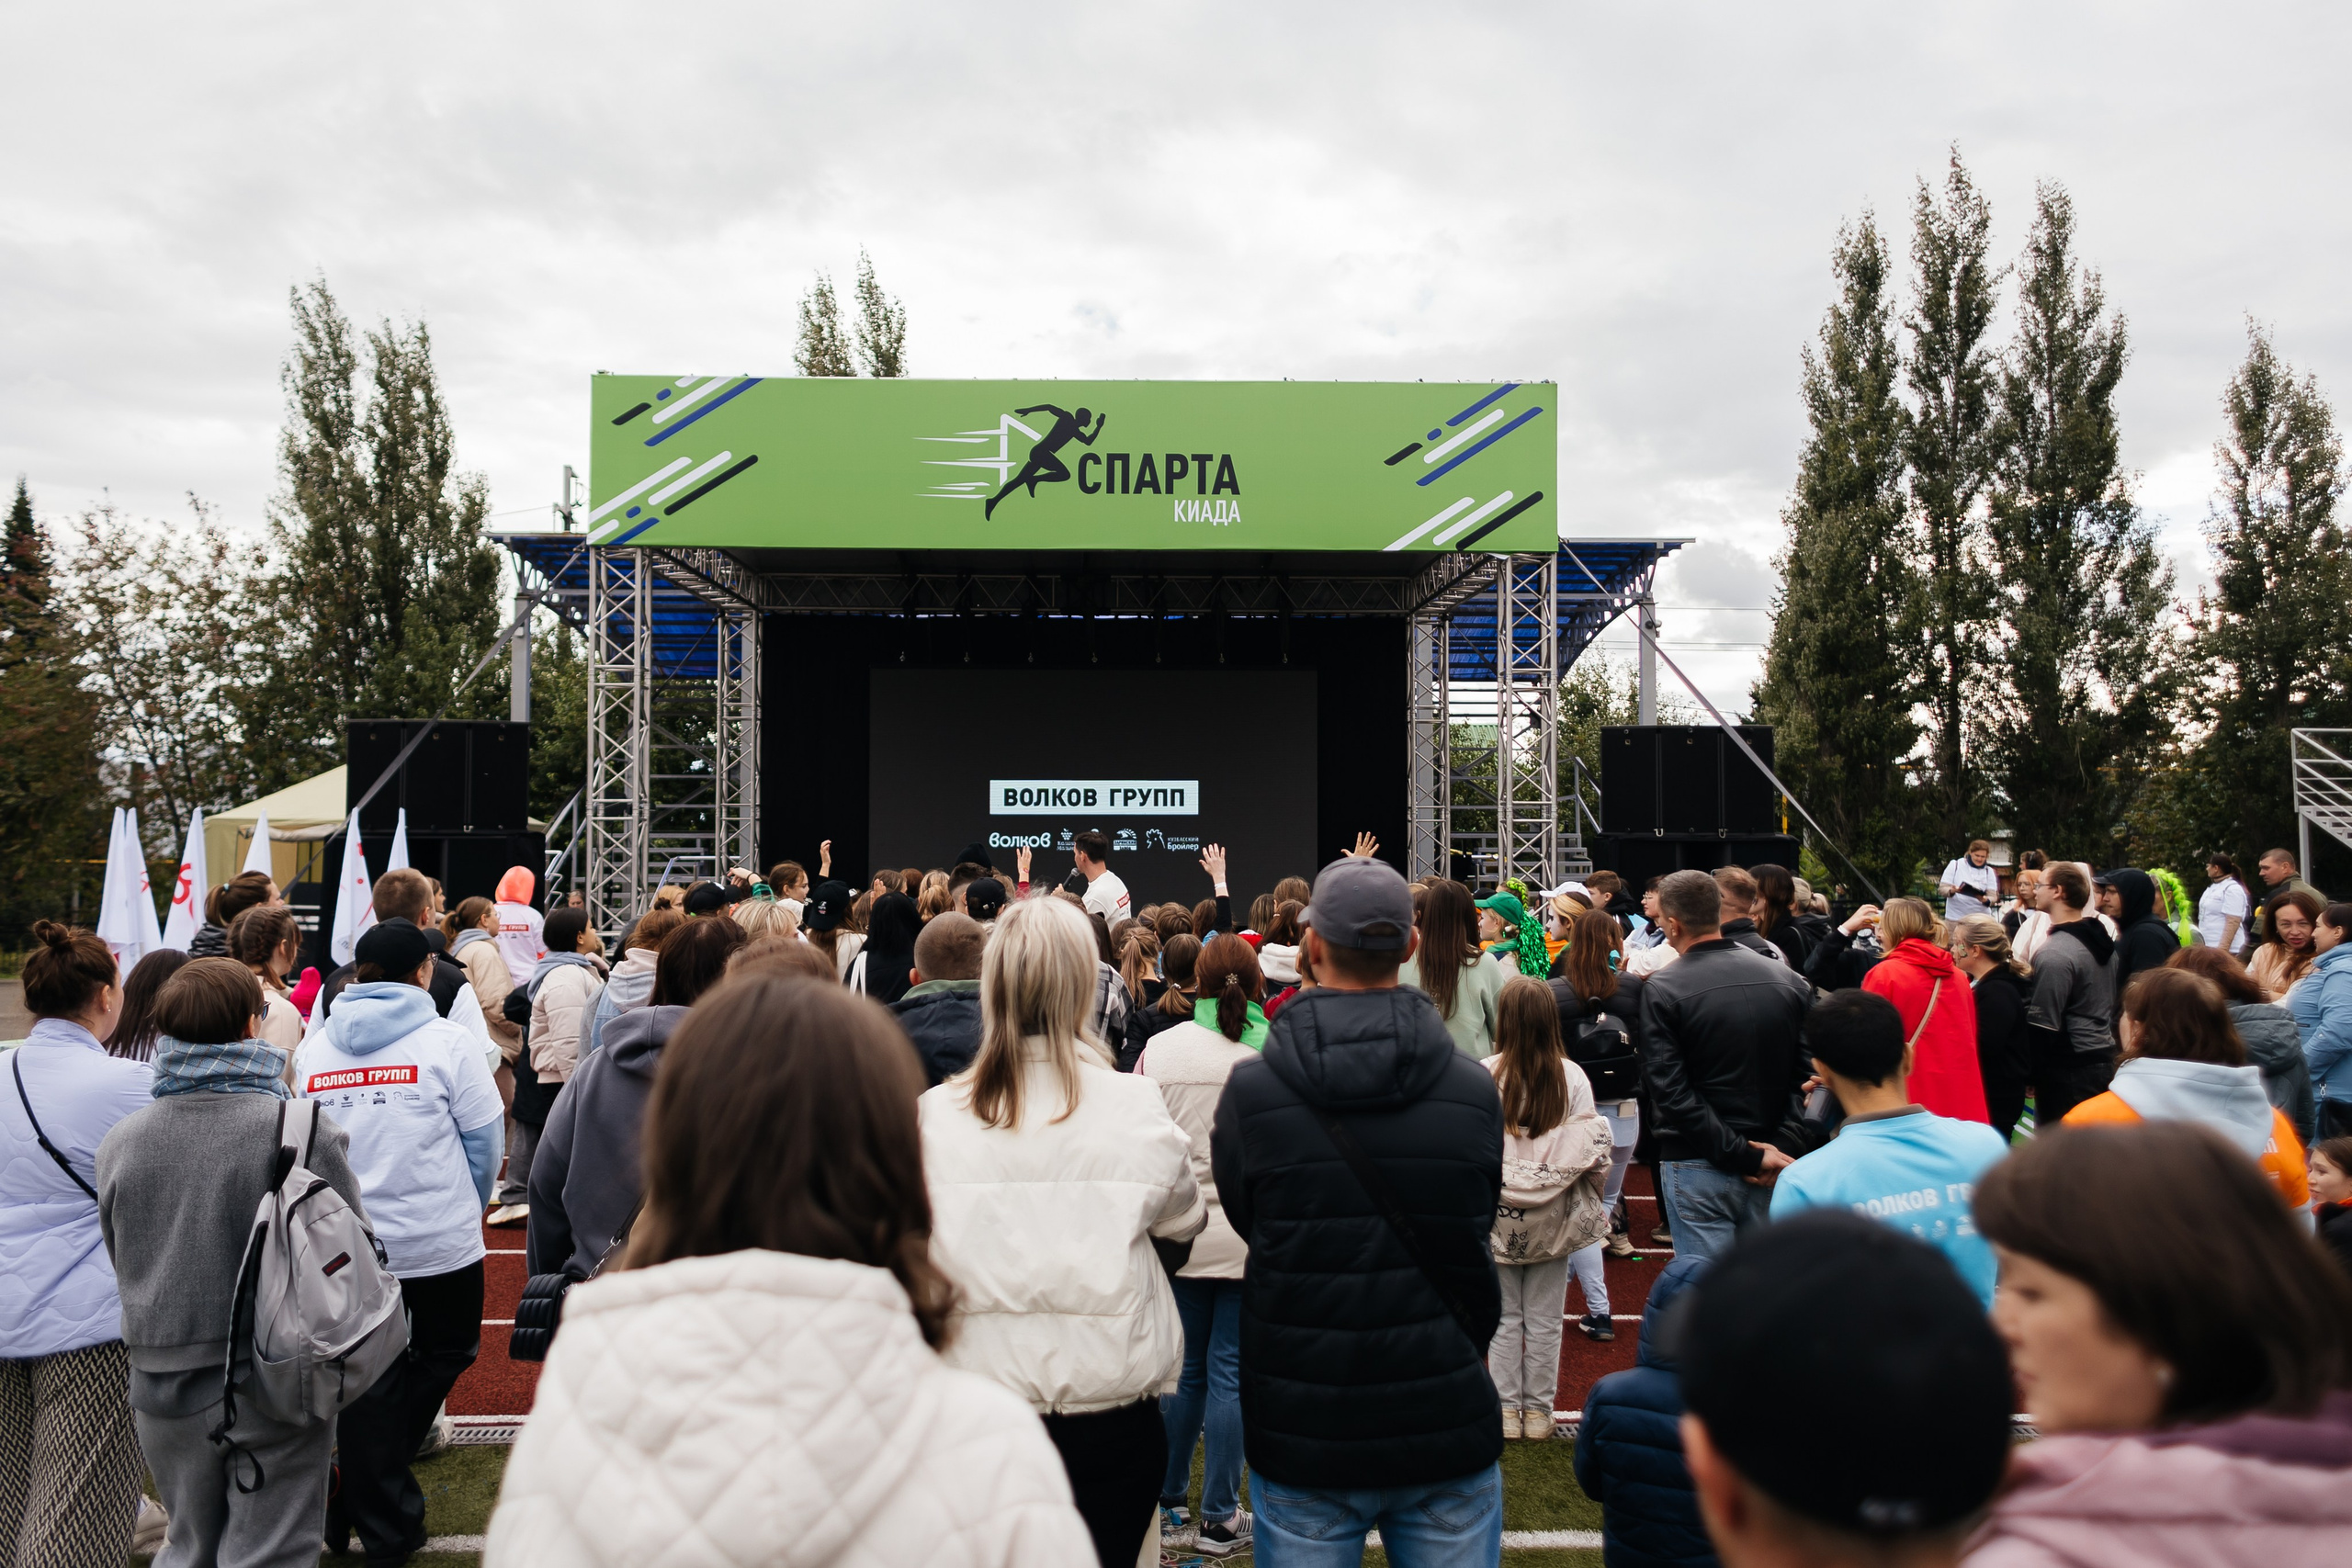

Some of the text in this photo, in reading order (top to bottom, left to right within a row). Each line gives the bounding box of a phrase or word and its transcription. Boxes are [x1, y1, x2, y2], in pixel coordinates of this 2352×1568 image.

[1078, 452, 1241, 496] СПАРТА
[1173, 499, 1241, 526] КИАДА
[1002, 787, 1185, 807] ВОЛКОВ ГРУПП
[1167, 841, 1199, 852] Бройлер
[314, 1069, 411, 1089] ВОЛКОВ ГРУПП
